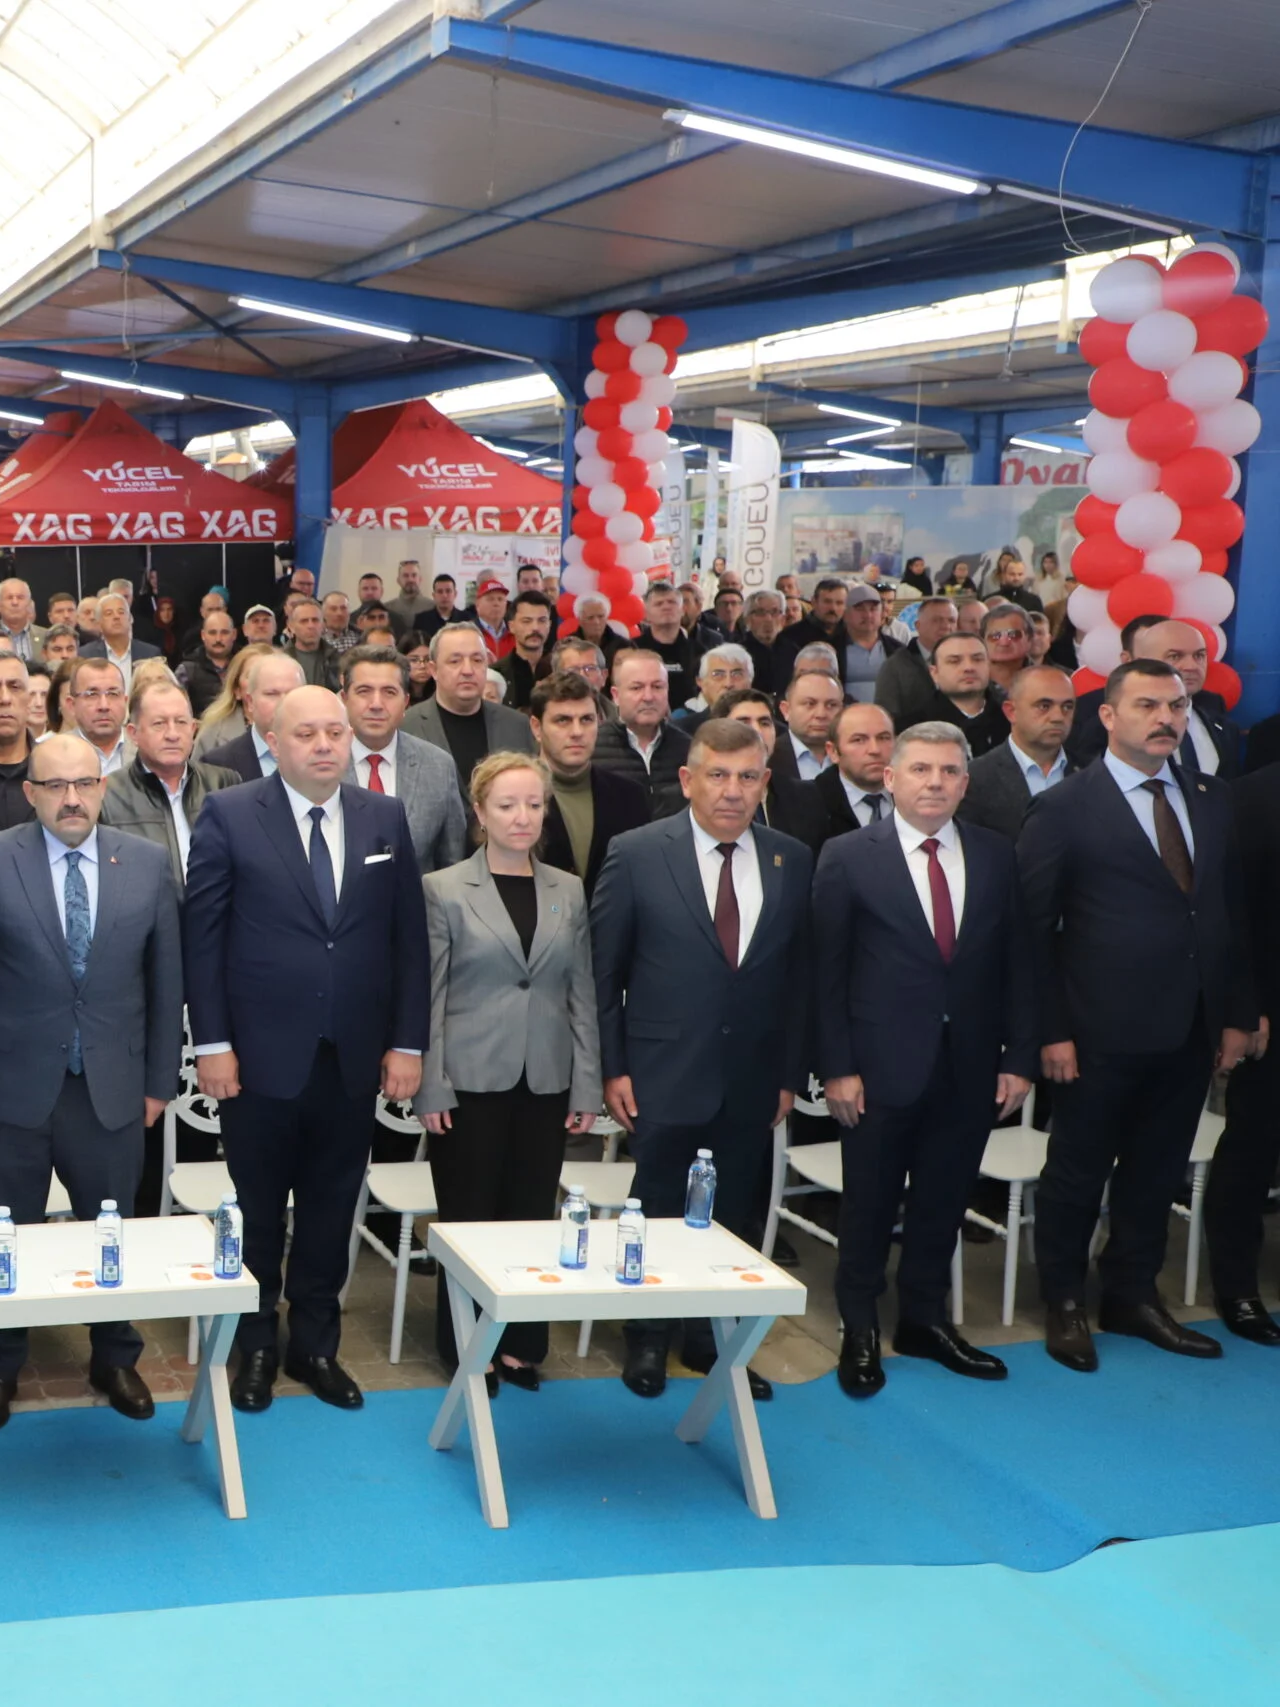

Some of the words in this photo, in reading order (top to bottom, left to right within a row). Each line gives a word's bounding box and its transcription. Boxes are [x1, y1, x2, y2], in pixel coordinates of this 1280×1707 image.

[12, 512, 92, 542] XAG
[106, 511, 185, 540] XAG
[200, 508, 277, 538] XAG
[423, 506, 501, 532] XAG
[516, 506, 562, 533] XA
